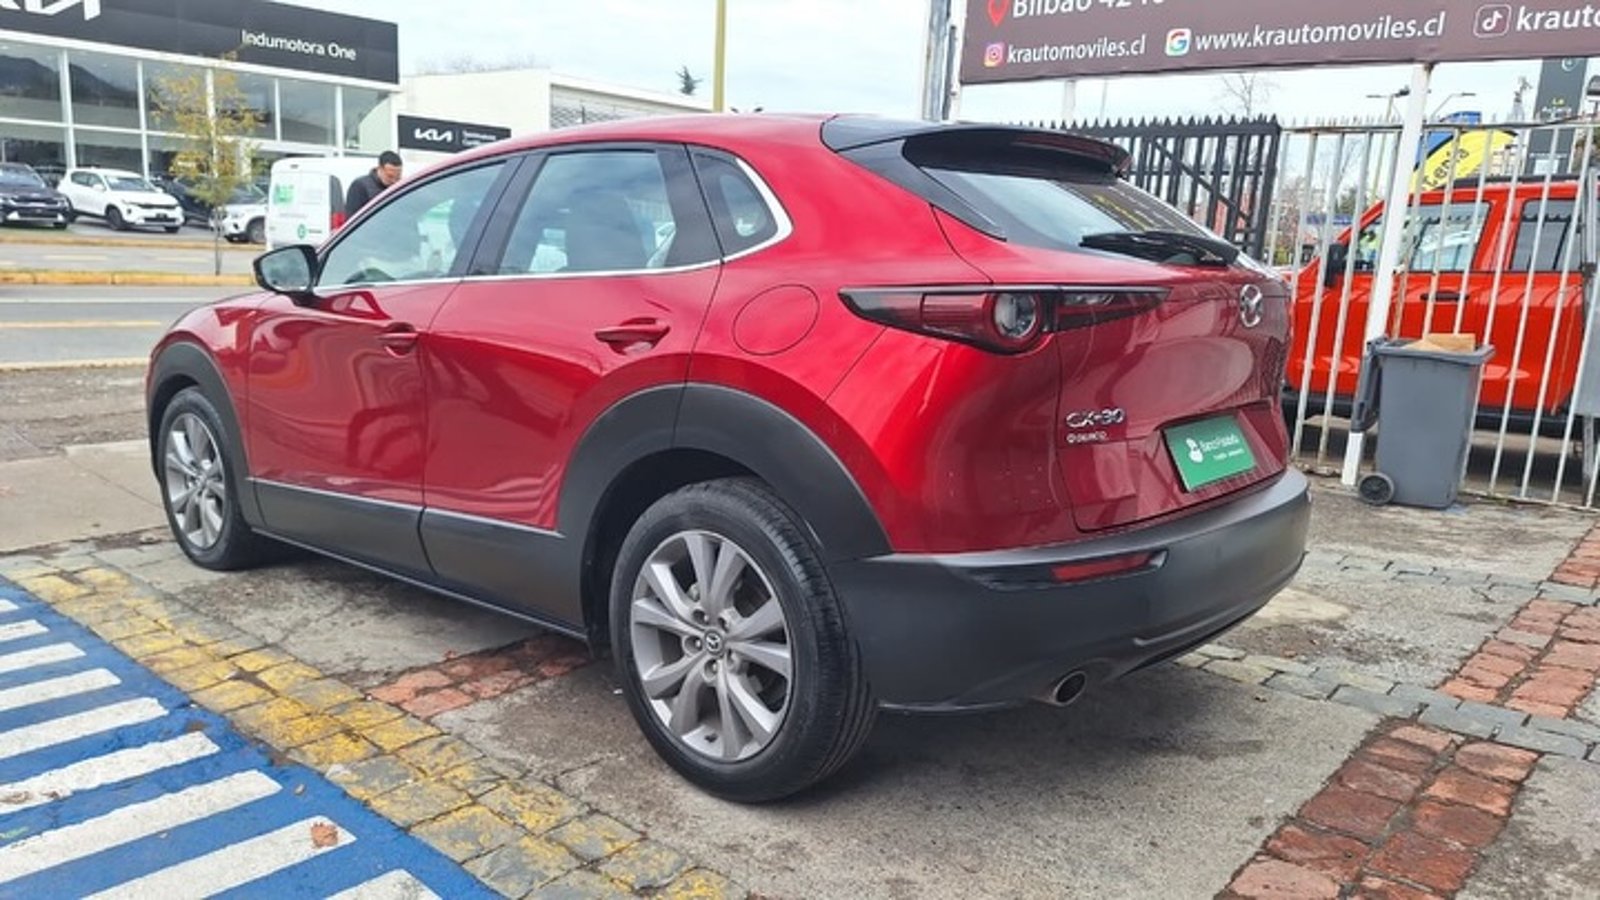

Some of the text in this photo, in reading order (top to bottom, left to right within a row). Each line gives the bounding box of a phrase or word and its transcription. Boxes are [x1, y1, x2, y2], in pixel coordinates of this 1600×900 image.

[241, 29, 357, 61] Indumotora One
[1195, 11, 1446, 50] www.krautomoviles.cl
[1007, 34, 1147, 64] krautomoviles.cl
[1066, 408, 1125, 428] CX-30
